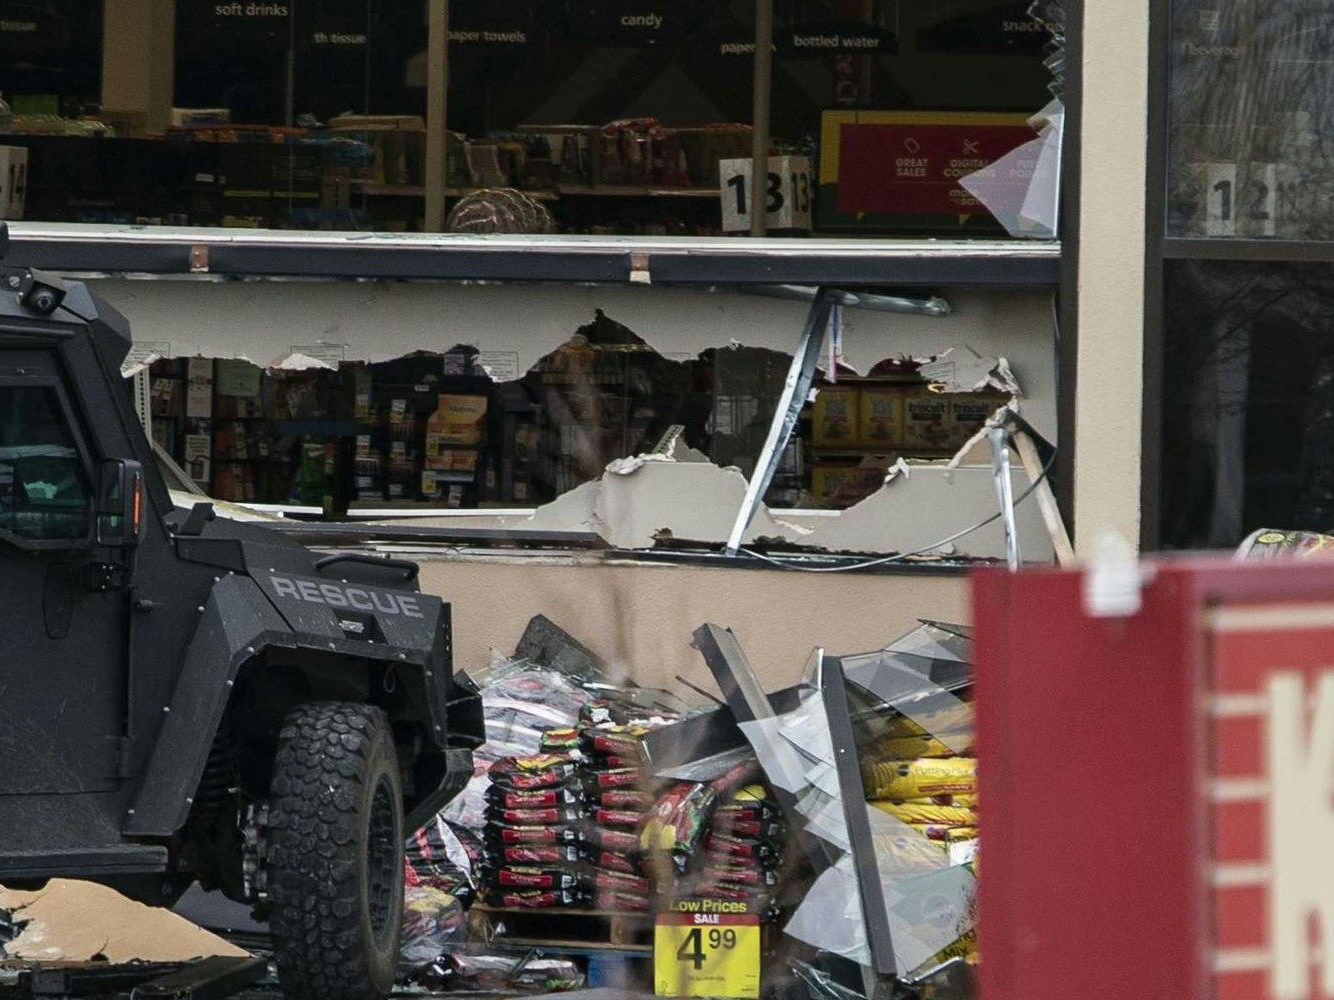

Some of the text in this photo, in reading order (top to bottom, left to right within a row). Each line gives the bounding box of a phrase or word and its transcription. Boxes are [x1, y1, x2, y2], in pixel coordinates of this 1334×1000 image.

[215, 2, 289, 16] soft drinks
[620, 14, 663, 29] candy
[483, 30, 526, 43] towels
[793, 34, 880, 48] bottled water
[895, 158, 929, 168] GREAT
[895, 167, 927, 177] SALES
[727, 173, 784, 215] 13
[269, 575, 425, 619] RESCUE
[669, 899, 748, 912] Low Prices
[694, 913, 720, 924] SALE
